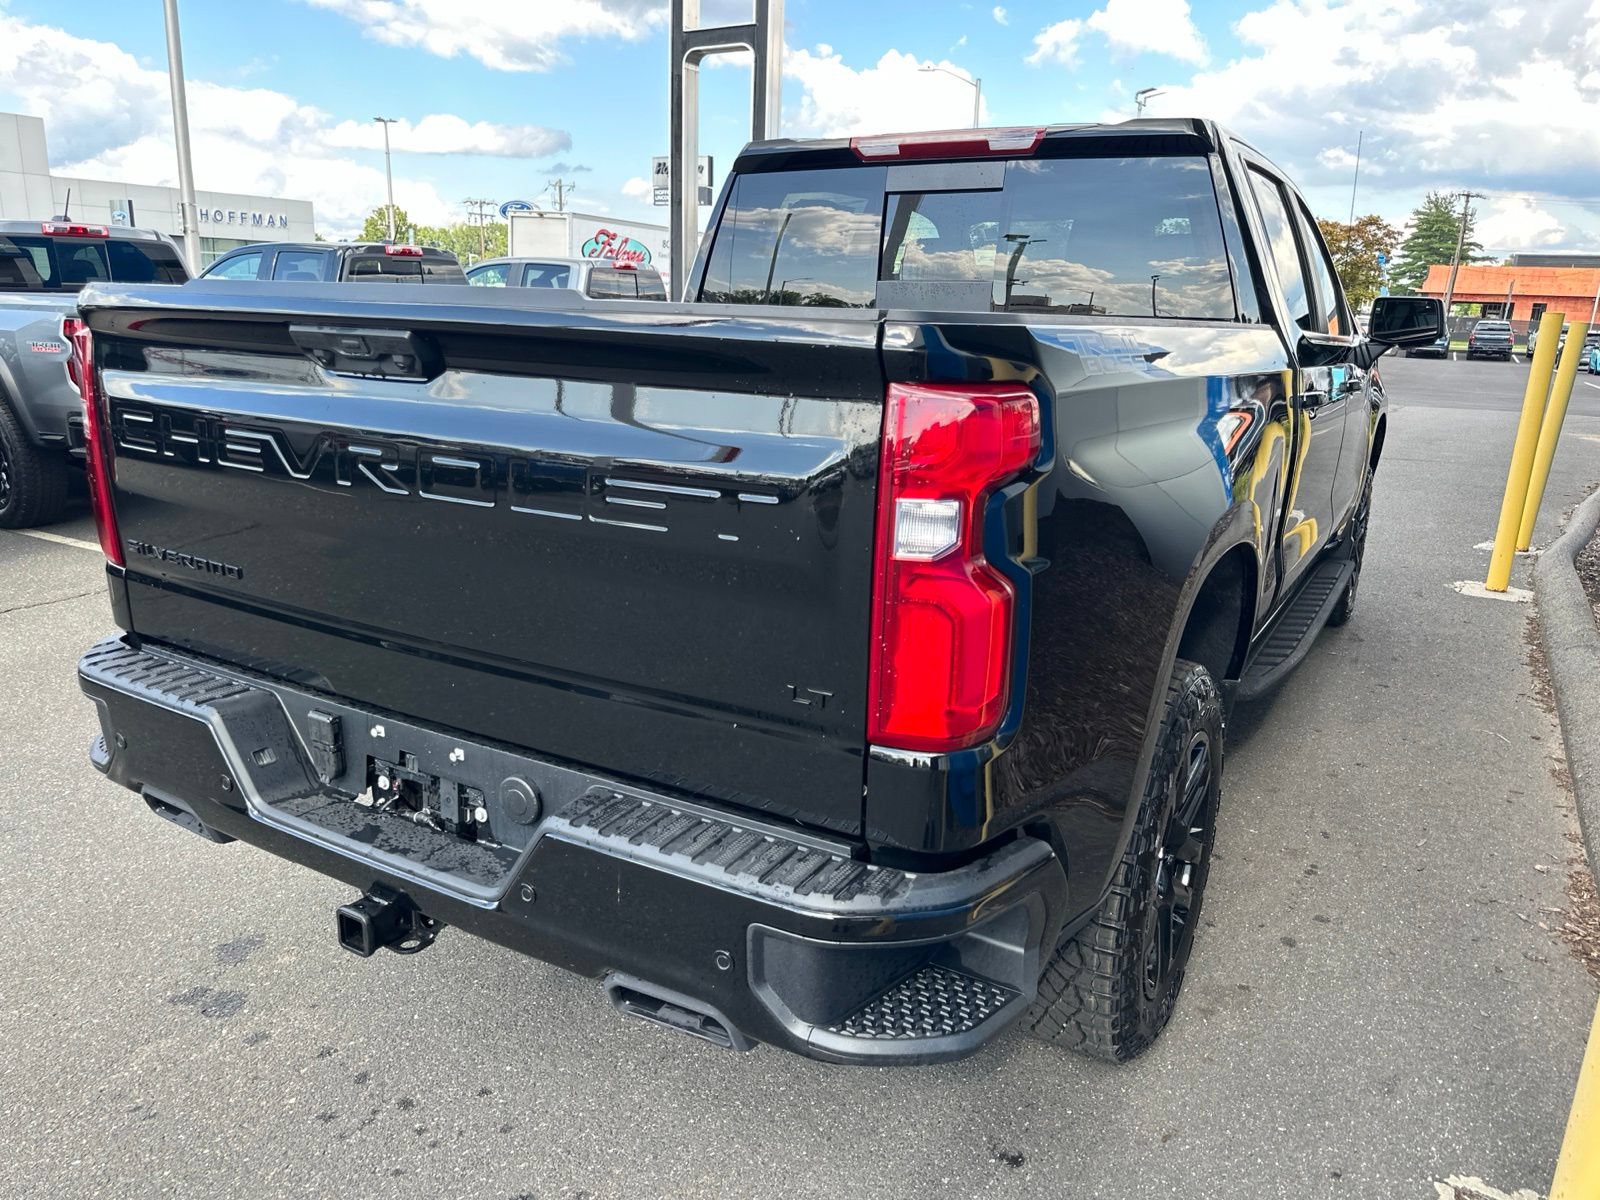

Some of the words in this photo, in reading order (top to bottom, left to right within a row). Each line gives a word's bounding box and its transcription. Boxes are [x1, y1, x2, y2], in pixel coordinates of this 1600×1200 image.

[199, 208, 288, 226] HOFFMAN
[1057, 333, 1151, 356] TRAIL
[1079, 354, 1149, 375] BOSS
[115, 406, 780, 541] CHEVROLET
[127, 538, 244, 580] SILVERADO
[786, 684, 835, 709] LT
